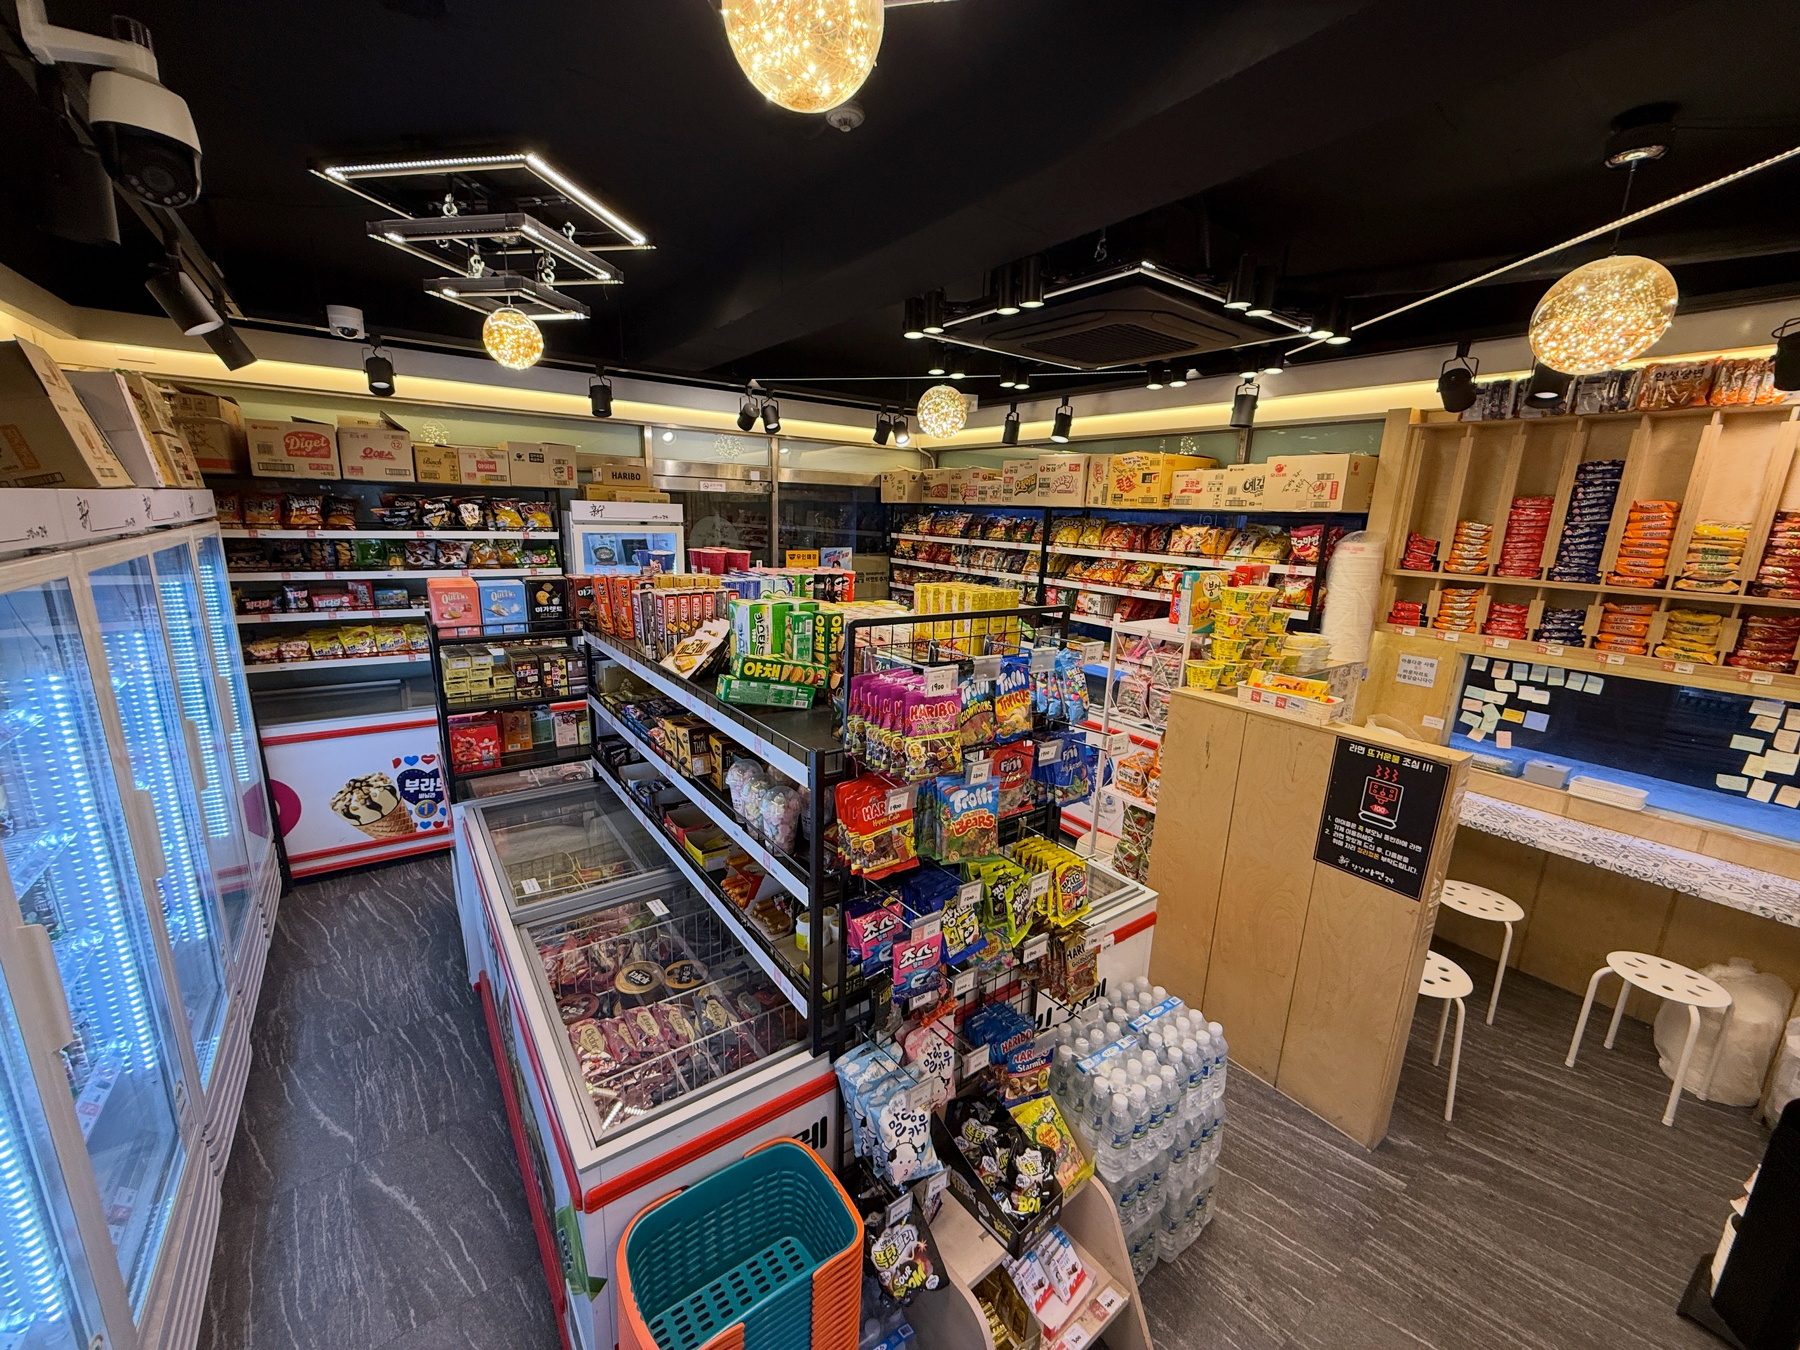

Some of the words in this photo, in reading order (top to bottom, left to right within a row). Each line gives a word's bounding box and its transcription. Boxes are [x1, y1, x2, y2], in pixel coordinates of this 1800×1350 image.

[286, 436, 328, 451] Diget
[360, 446, 396, 460] 오예스
[611, 471, 641, 481] HARIBO
[290, 498, 320, 510] Nacho
[744, 662, 782, 678] 야채
[1401, 658, 1423, 666] 아름다운
[1424, 660, 1435, 668] 사람
[931, 682, 944, 692] 1900
[909, 702, 956, 723] HARIBO
[1349, 743, 1366, 755] 라면
[1402, 757, 1420, 770] 조심
[950, 787, 993, 812] Trolli
[862, 801, 886, 822] HAR
[952, 816, 994, 836] BEARS
[1409, 842, 1422, 853] 라면
[1001, 1029, 1034, 1053] HARIBO
[873, 1244, 899, 1270] 폭탄
[894, 1264, 913, 1288] SOUR
